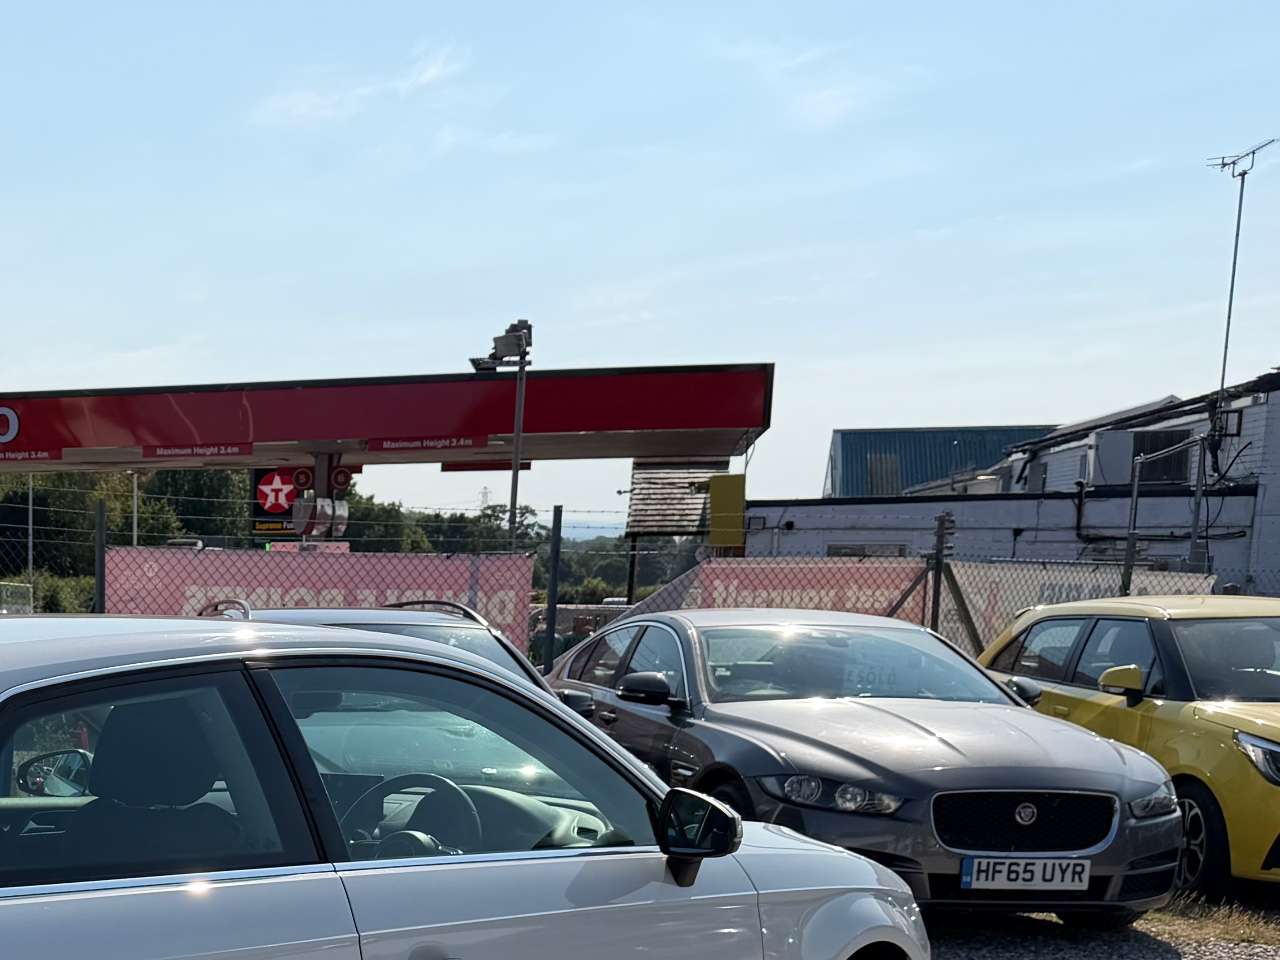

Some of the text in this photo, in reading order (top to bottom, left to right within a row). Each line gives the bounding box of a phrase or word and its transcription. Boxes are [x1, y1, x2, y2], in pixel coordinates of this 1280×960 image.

[423, 439, 449, 449] Height
[5, 451, 29, 459] Height
[193, 446, 218, 455] Height
[271, 488, 283, 503] T
[975, 861, 1085, 883] HF65 UYR
